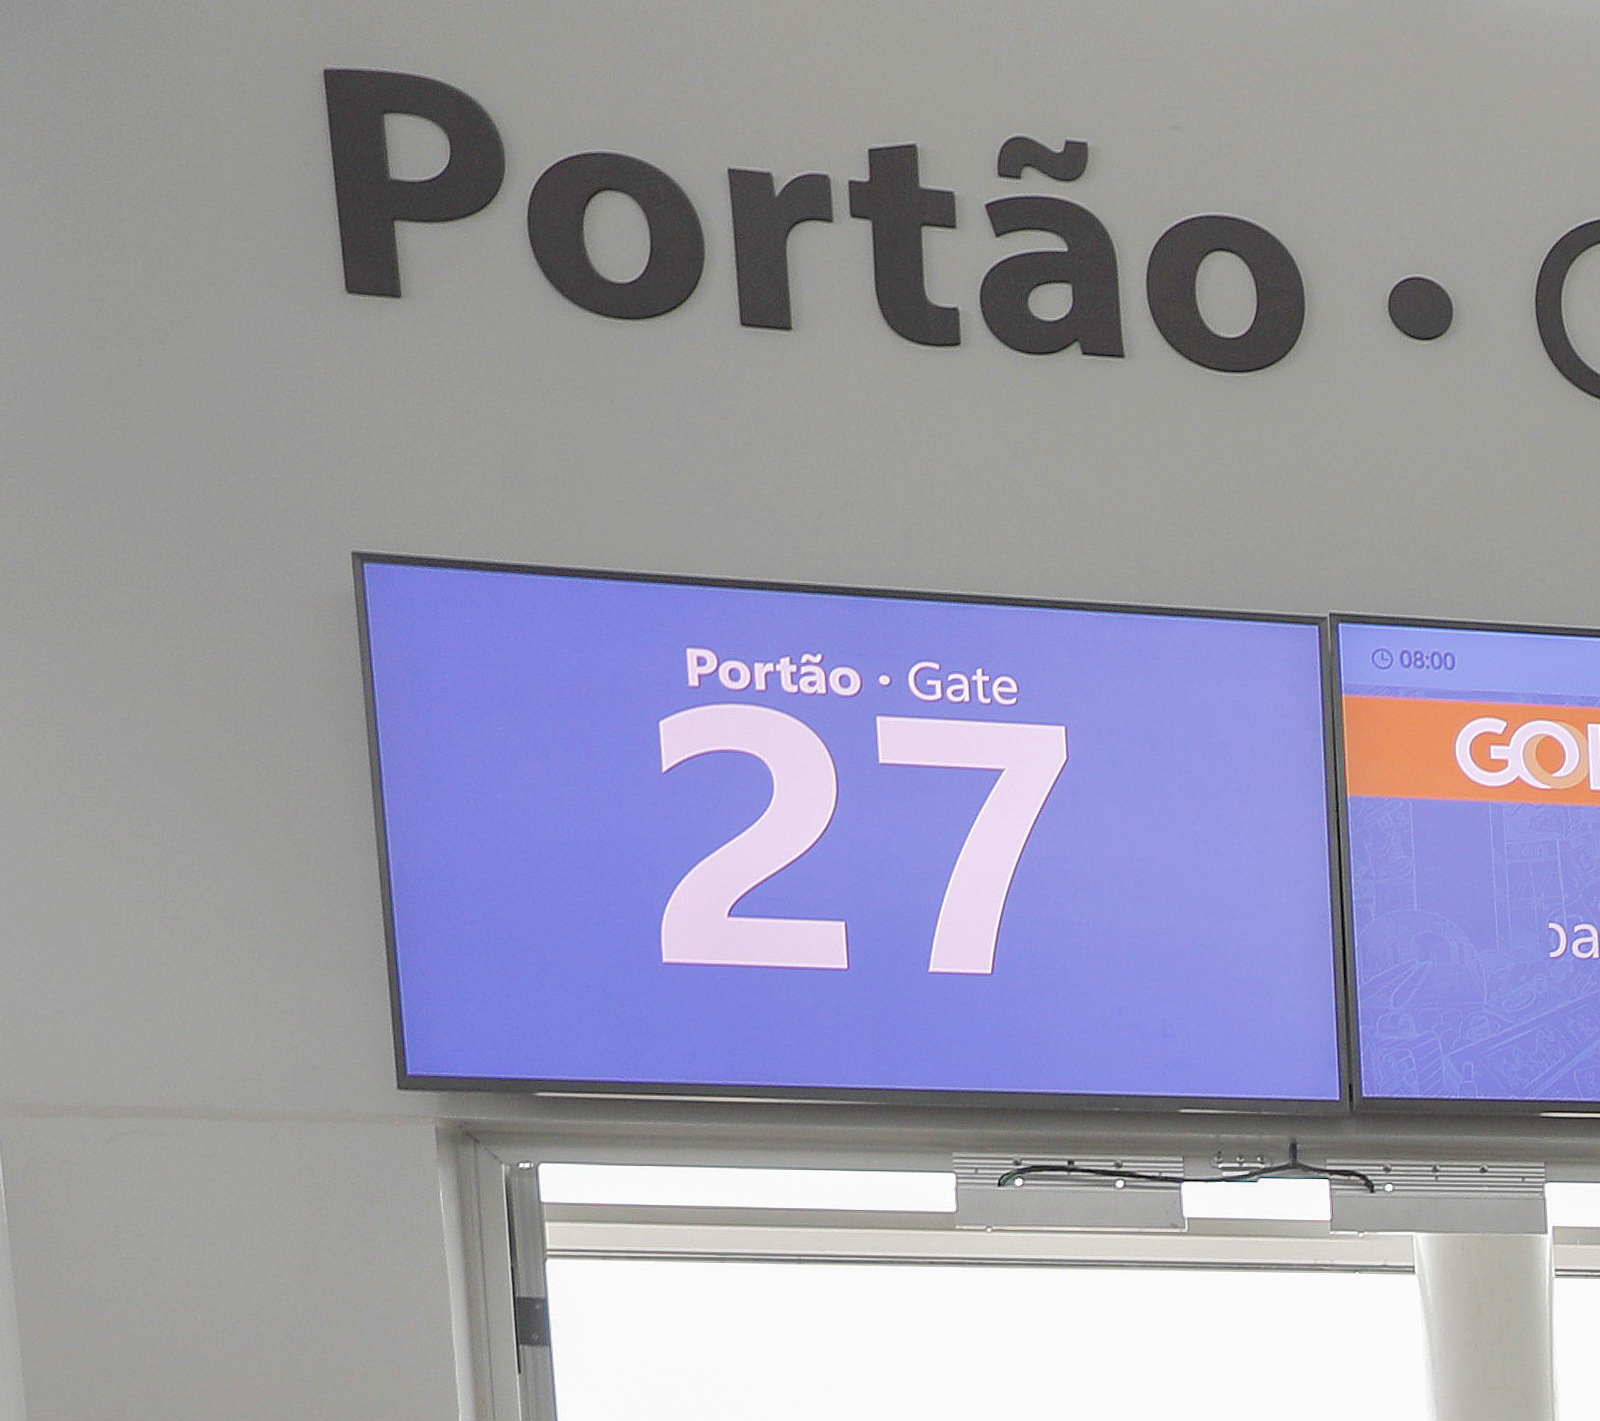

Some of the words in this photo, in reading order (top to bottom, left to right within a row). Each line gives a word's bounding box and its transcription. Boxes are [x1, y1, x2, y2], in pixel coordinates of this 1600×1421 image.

[322, 66, 1308, 376] Portão
[684, 647, 862, 698] Portão
[906, 658, 1019, 707] Gate
[1400, 650, 1456, 672] 08:00
[655, 701, 1070, 976] 27
